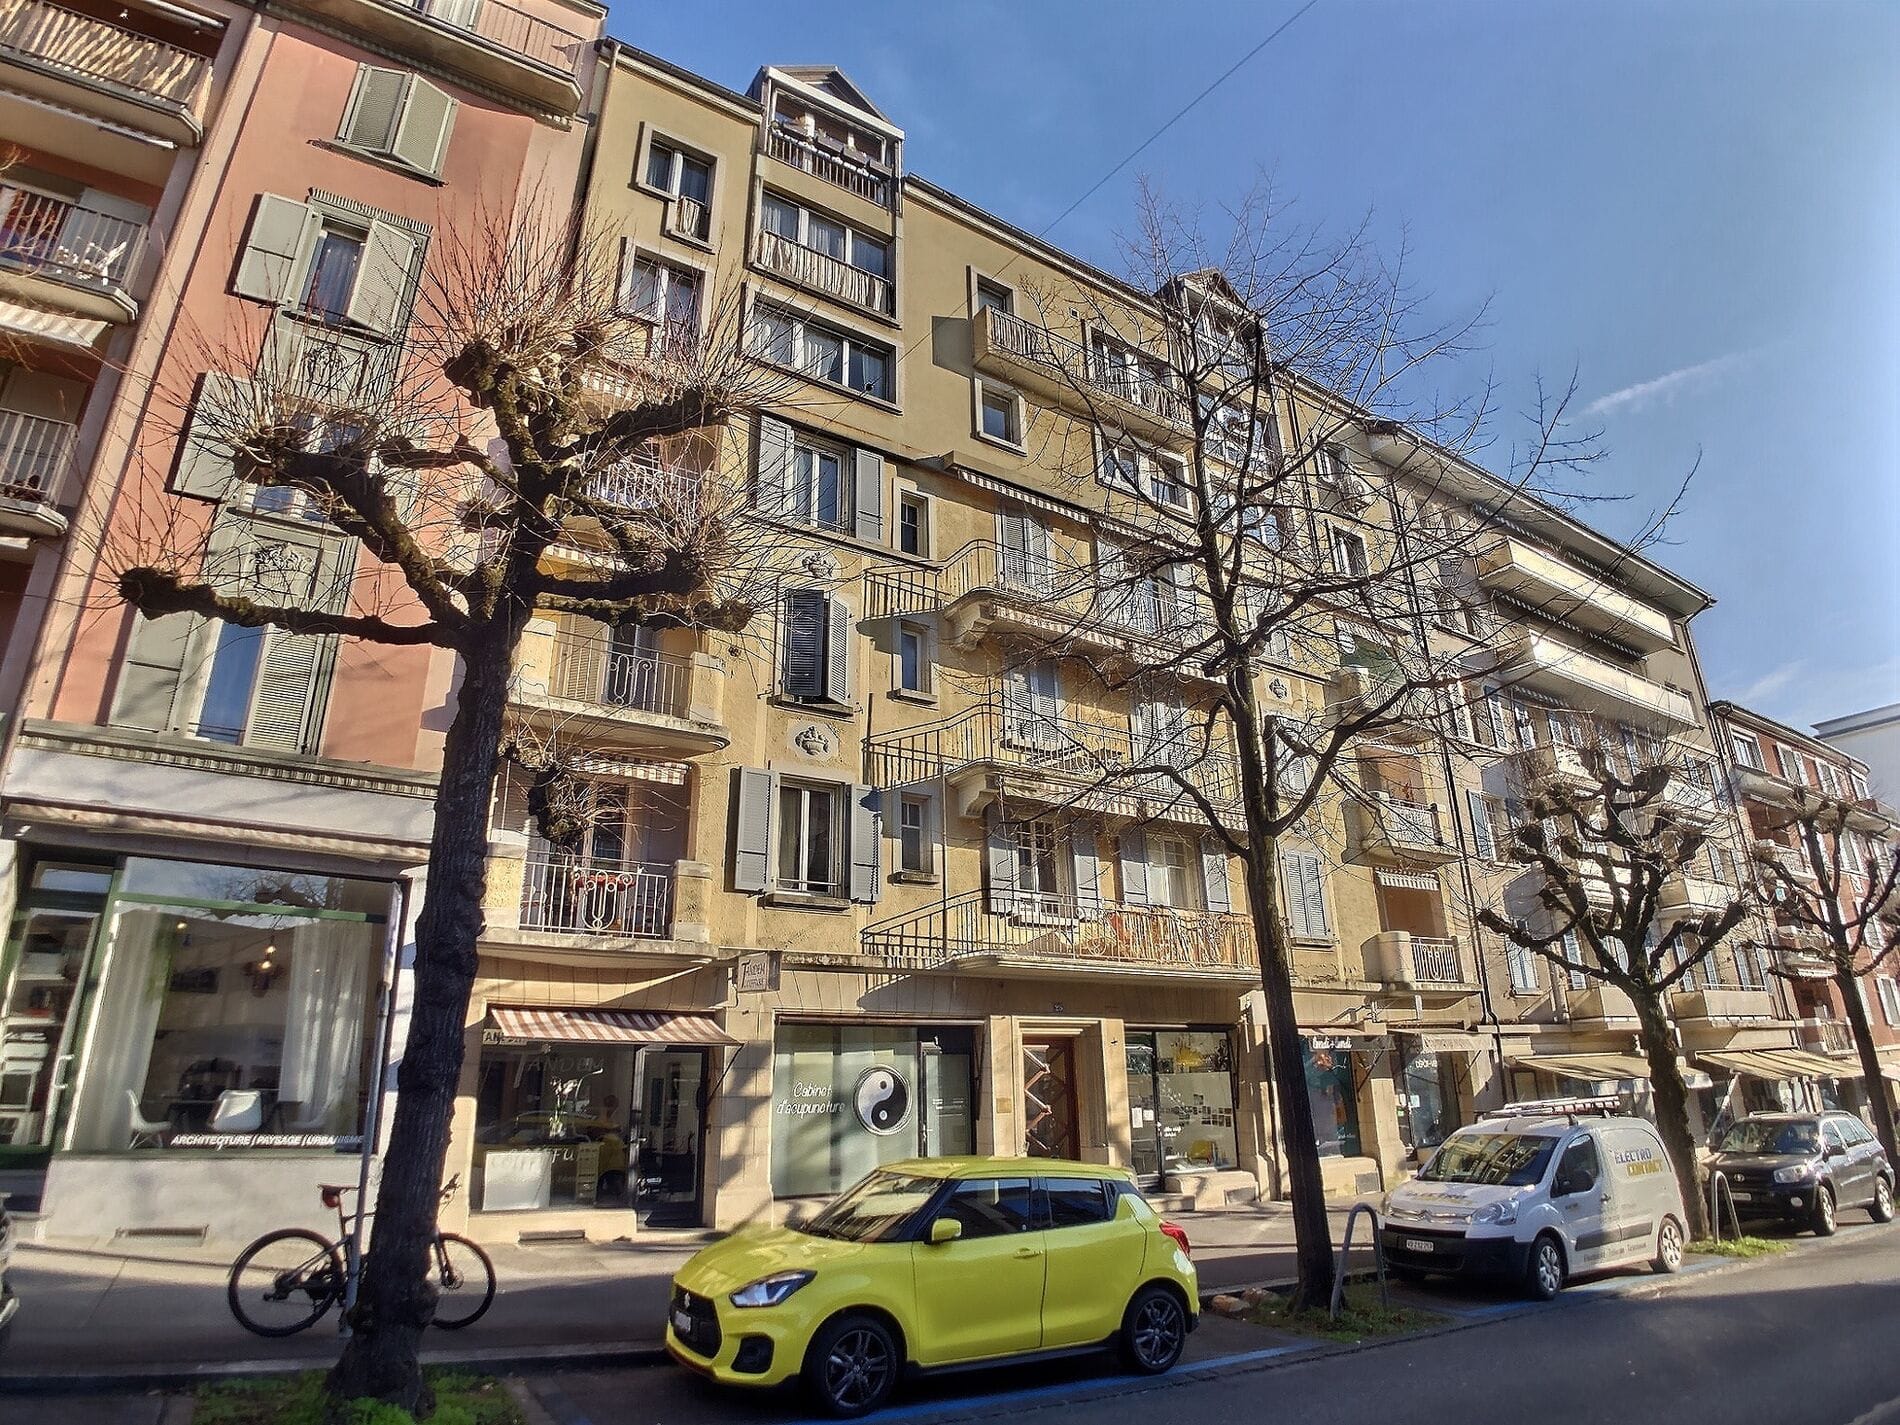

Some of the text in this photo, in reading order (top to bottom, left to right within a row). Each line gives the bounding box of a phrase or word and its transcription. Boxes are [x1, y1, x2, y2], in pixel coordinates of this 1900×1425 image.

[793, 1081, 832, 1098] Cabinet
[255, 1135, 301, 1146] PAYSAGE
[1615, 1148, 1652, 1164] ELECTRO
